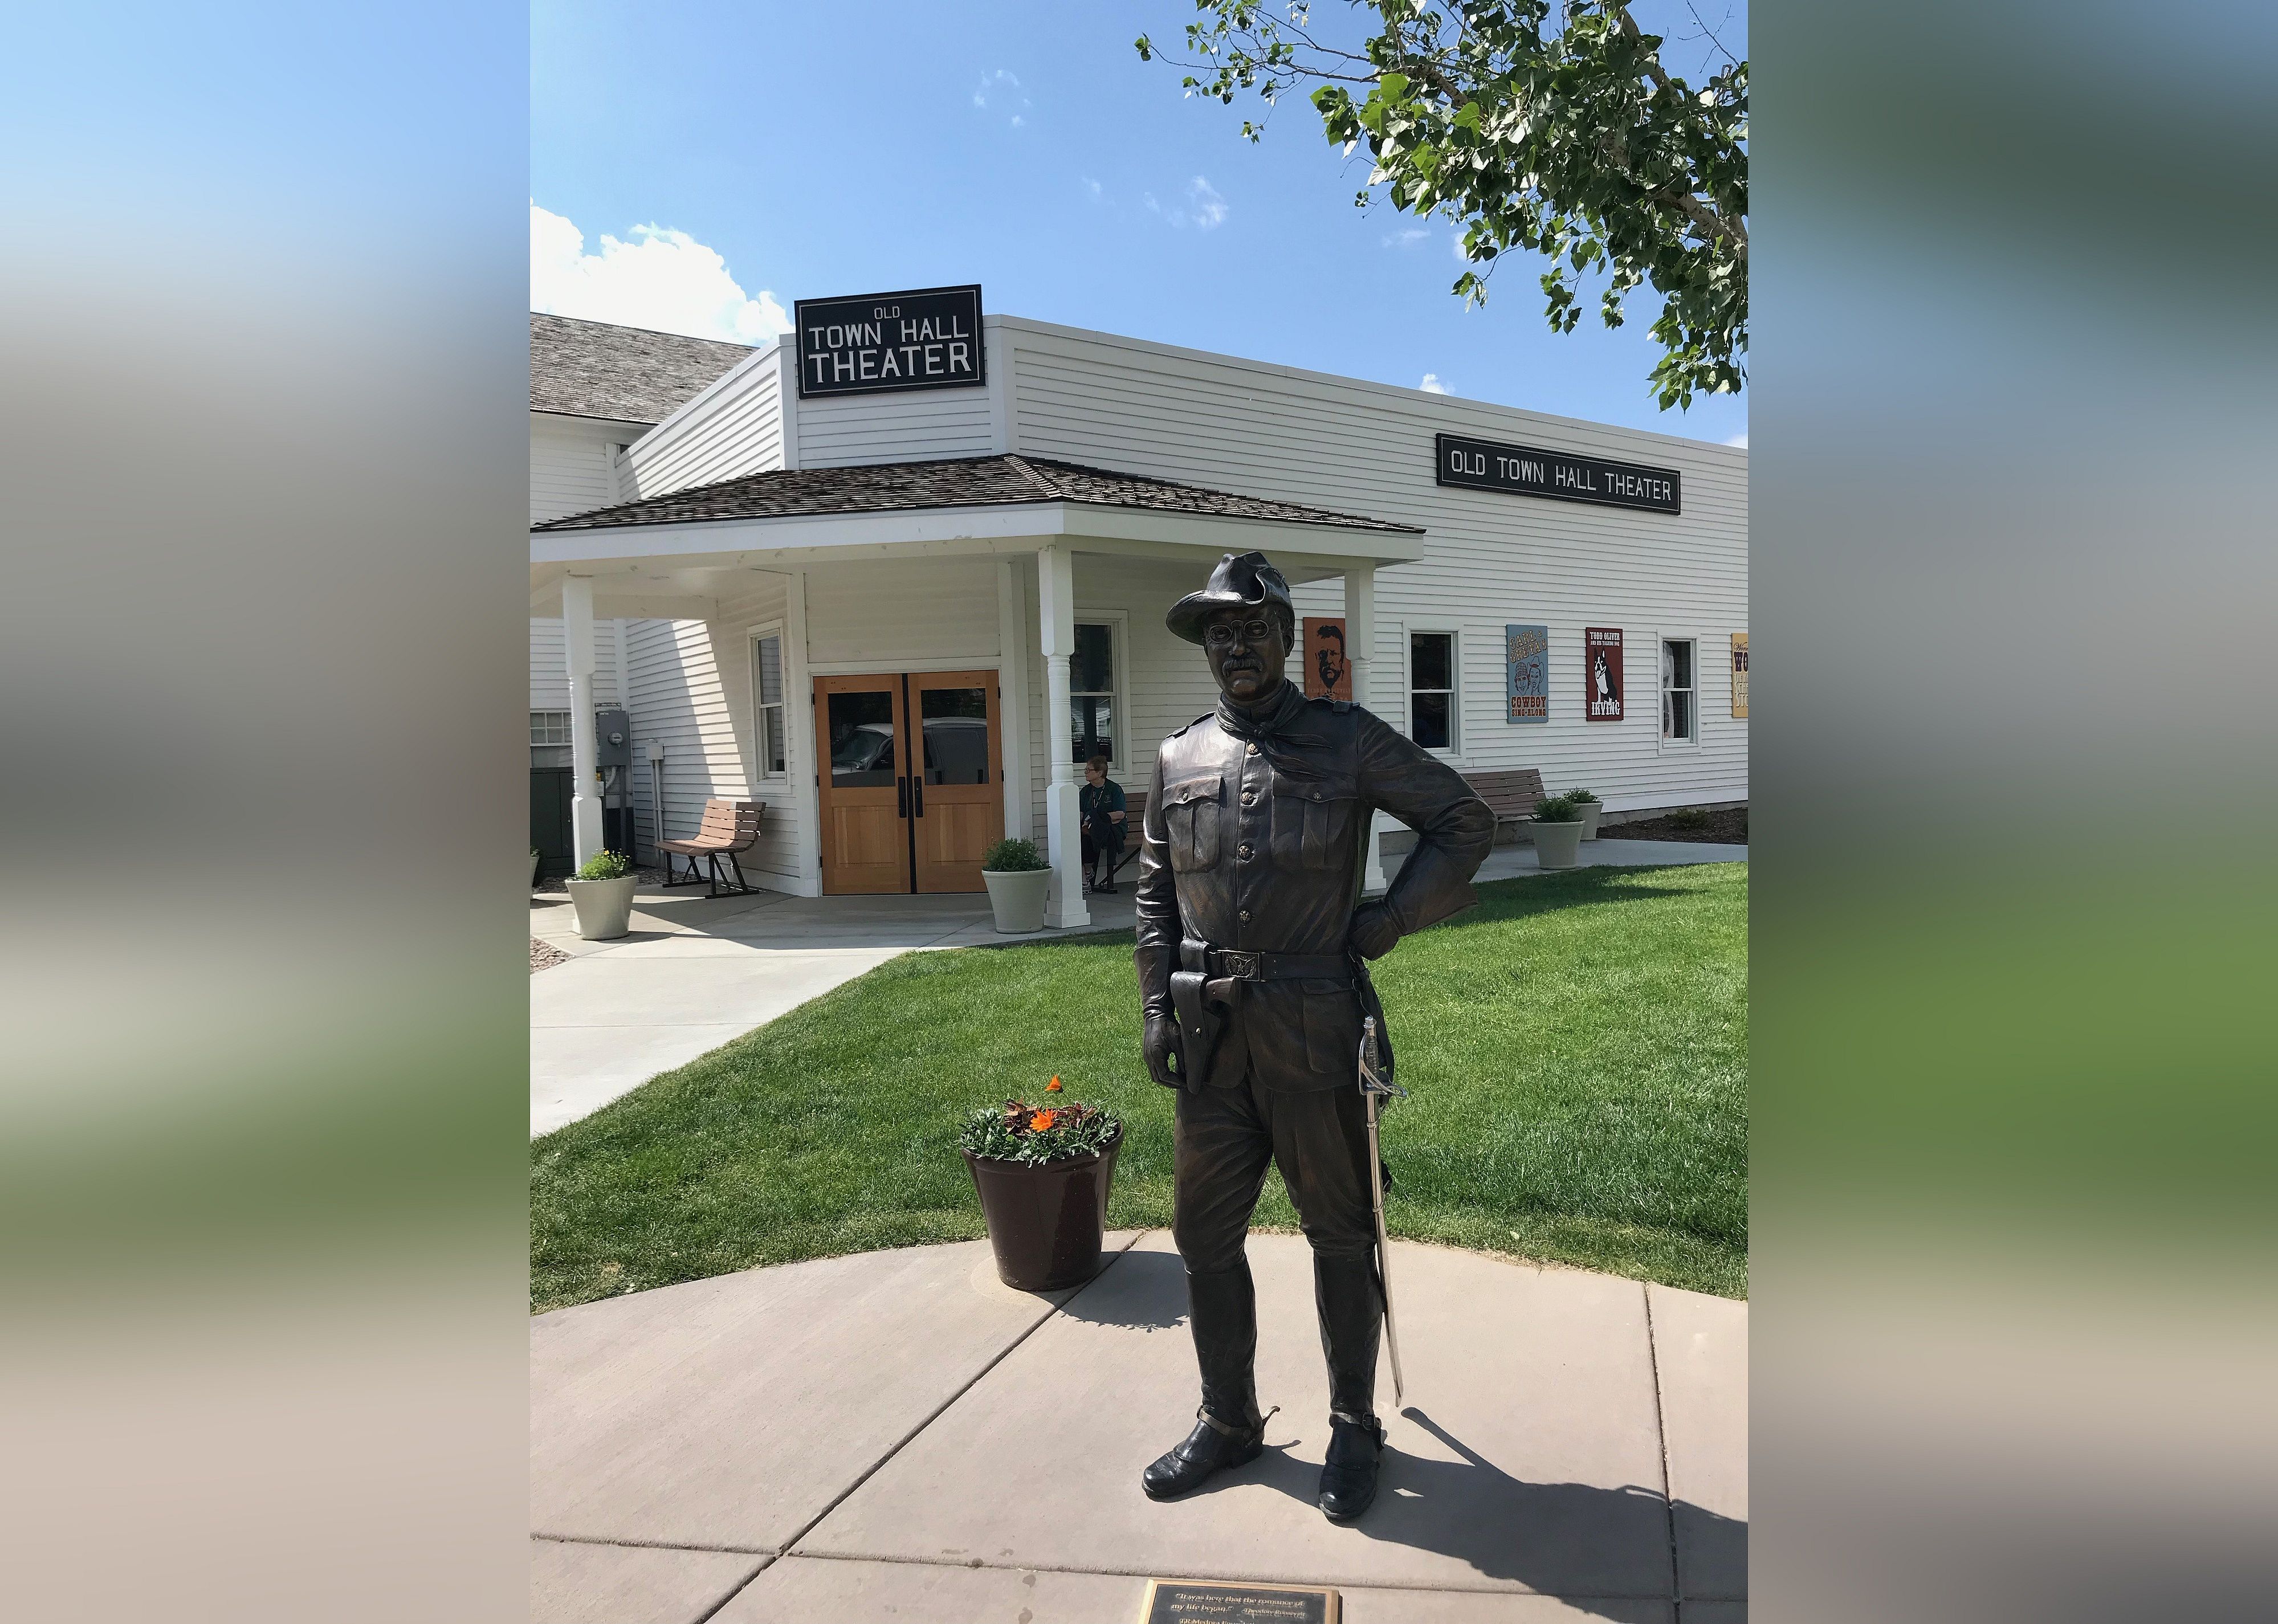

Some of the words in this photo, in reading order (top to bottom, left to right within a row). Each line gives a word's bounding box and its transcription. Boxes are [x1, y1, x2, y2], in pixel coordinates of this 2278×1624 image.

[874, 305, 900, 320] OLD
[808, 322, 882, 350] TOWN
[900, 315, 969, 342] HALL
[808, 342, 972, 383] THEATER
[1450, 450, 1486, 476] OLD
[1497, 456, 1544, 484] TOWN
[1555, 464, 1597, 491] HALL
[1604, 472, 1672, 501] THEATER
[1509, 630, 1537, 650] CARL
[1590, 631, 1603, 640] TODD
[1604, 632, 1620, 640] OLIVER
[1511, 696, 1546, 708] COWBOY
[1591, 700, 1620, 715] IRVING
[1511, 708, 1546, 717] SING-ALONG
